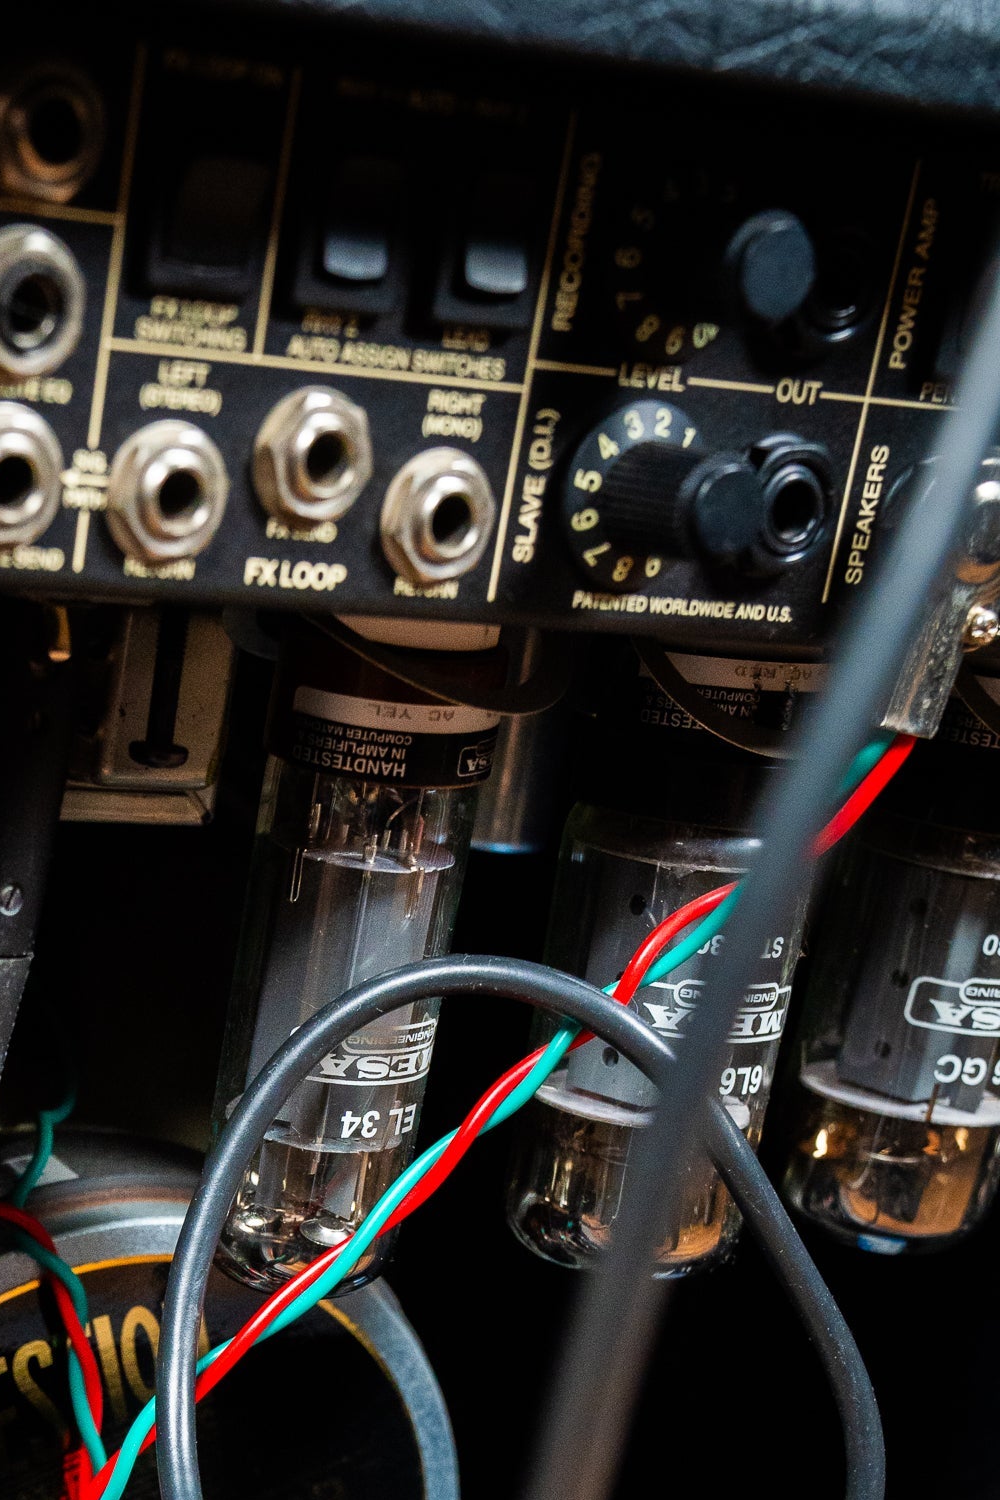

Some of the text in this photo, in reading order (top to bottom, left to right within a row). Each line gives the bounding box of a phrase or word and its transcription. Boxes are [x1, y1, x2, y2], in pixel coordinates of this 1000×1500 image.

[888, 266, 926, 371] POWER
[412, 350, 506, 381] SWITCHES
[618, 361, 825, 405] LEVEL OUT
[427, 388, 487, 416] RIGHT
[623, 410, 645, 439] 3
[655, 408, 672, 437] 2
[598, 433, 619, 460] 4
[574, 469, 602, 493] 5
[512, 473, 547, 564] SLAVE
[571, 507, 599, 532] 6
[844, 444, 891, 585] SPEAKERS
[583, 541, 612, 567] 7
[243, 556, 349, 593] FX LOOP
[612, 556, 634, 582] 8
[572, 590, 793, 624] PATENTED WORLDWIDE AND U.S.
[307, 734, 407, 760] IN AMPLIFIERS
[346, 727, 413, 747] COMPUTER
[291, 743, 406, 778] HANDTESTED
[340, 1102, 417, 1139] EL 34
